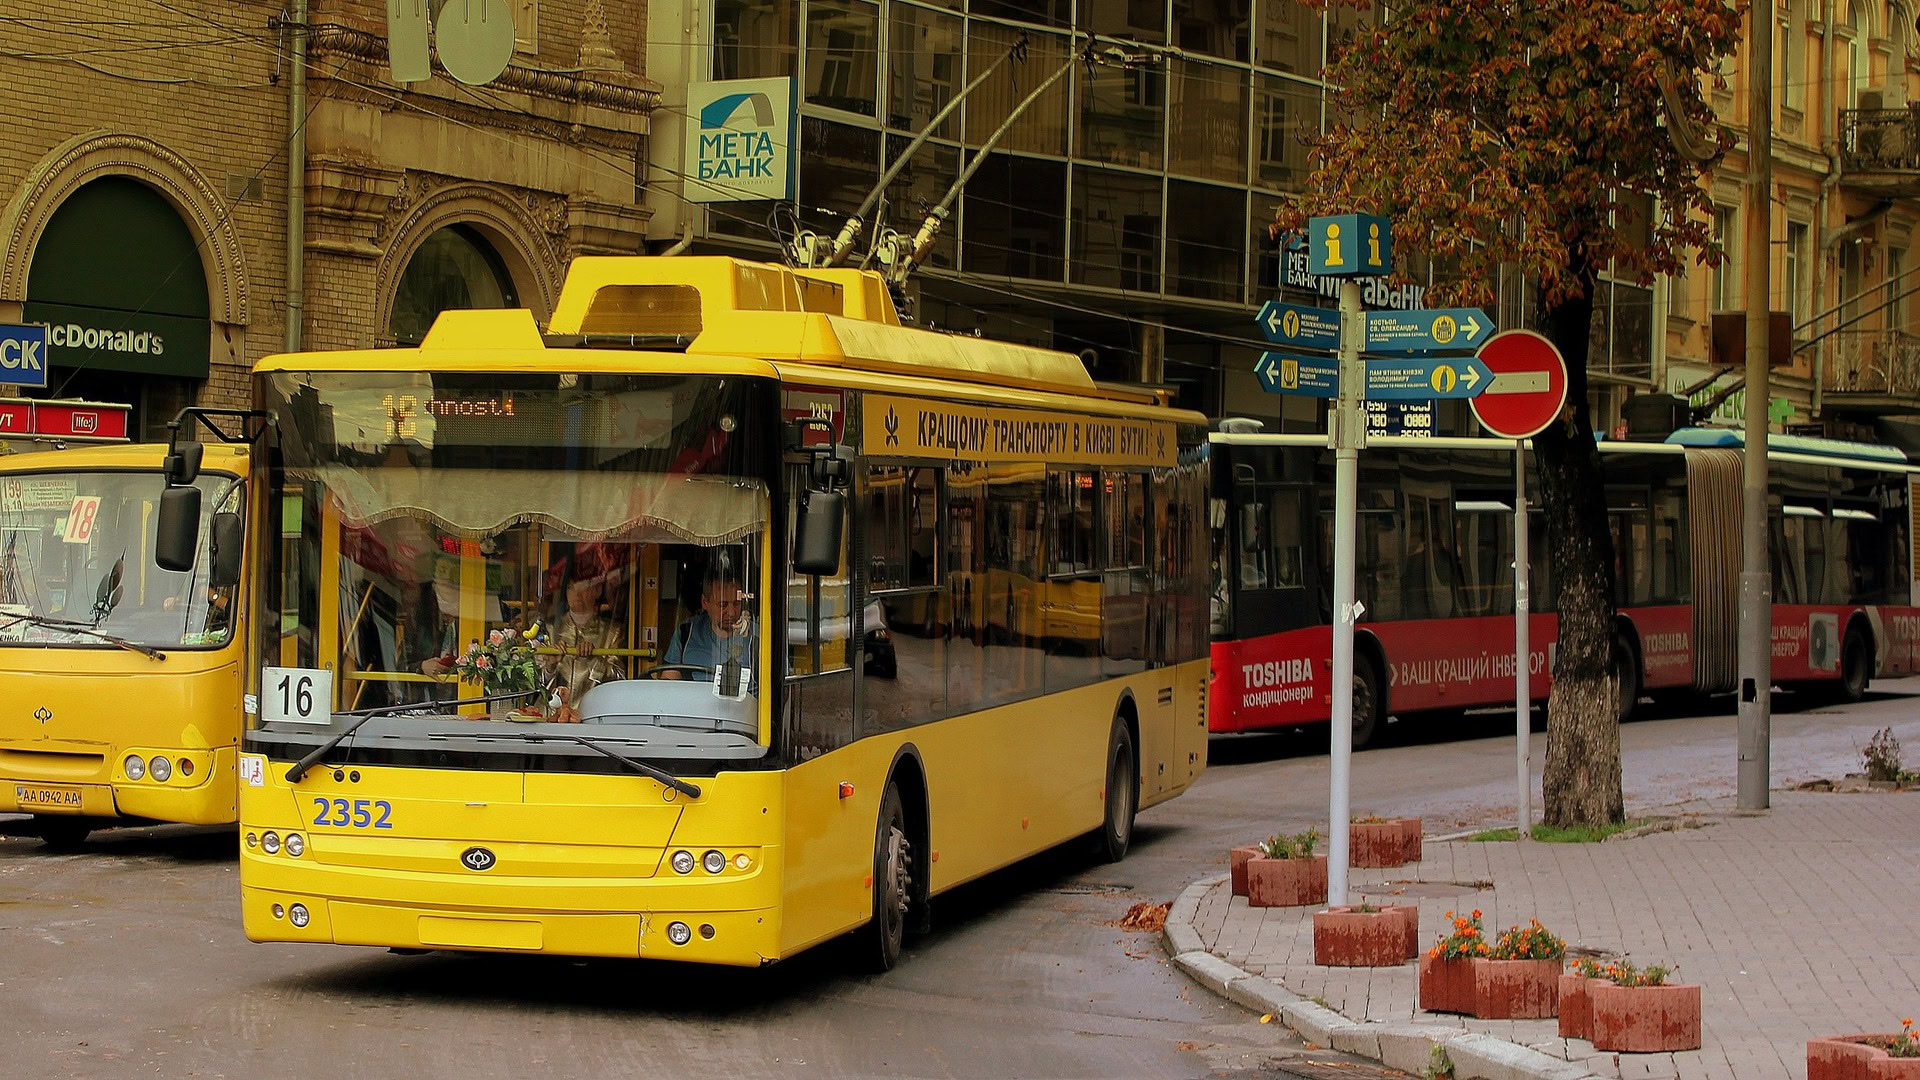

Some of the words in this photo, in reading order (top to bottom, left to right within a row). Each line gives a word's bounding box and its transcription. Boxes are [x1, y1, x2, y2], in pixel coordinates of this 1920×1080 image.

[700, 132, 774, 158] МЕТА
[699, 157, 774, 180] БАНК
[1288, 251, 1311, 273] МЕТ
[1287, 269, 1318, 290] БАНК
[917, 410, 988, 457] КРАЩОМУ
[993, 418, 1068, 455] ТРАНСПОРТУ
[1073, 422, 1080, 453] В
[1085, 423, 1115, 455] КИЄВІ
[70, 500, 97, 540] 18
[1645, 633, 1689, 652] TOSHIBA
[1242, 658, 1314, 688] TOSHIBA
[1401, 661, 1431, 686] ВАШ
[1435, 651, 1489, 685] КРАЩИЙ
[1492, 652, 1545, 677] ІНВЕОР
[278, 675, 314, 718] 16
[1243, 684, 1314, 708] кондиціонери
[23, 789, 37, 803] AA
[40, 790, 62, 804] 0942
[64, 792, 79, 805] AA
[313, 797, 393, 829] 2352
